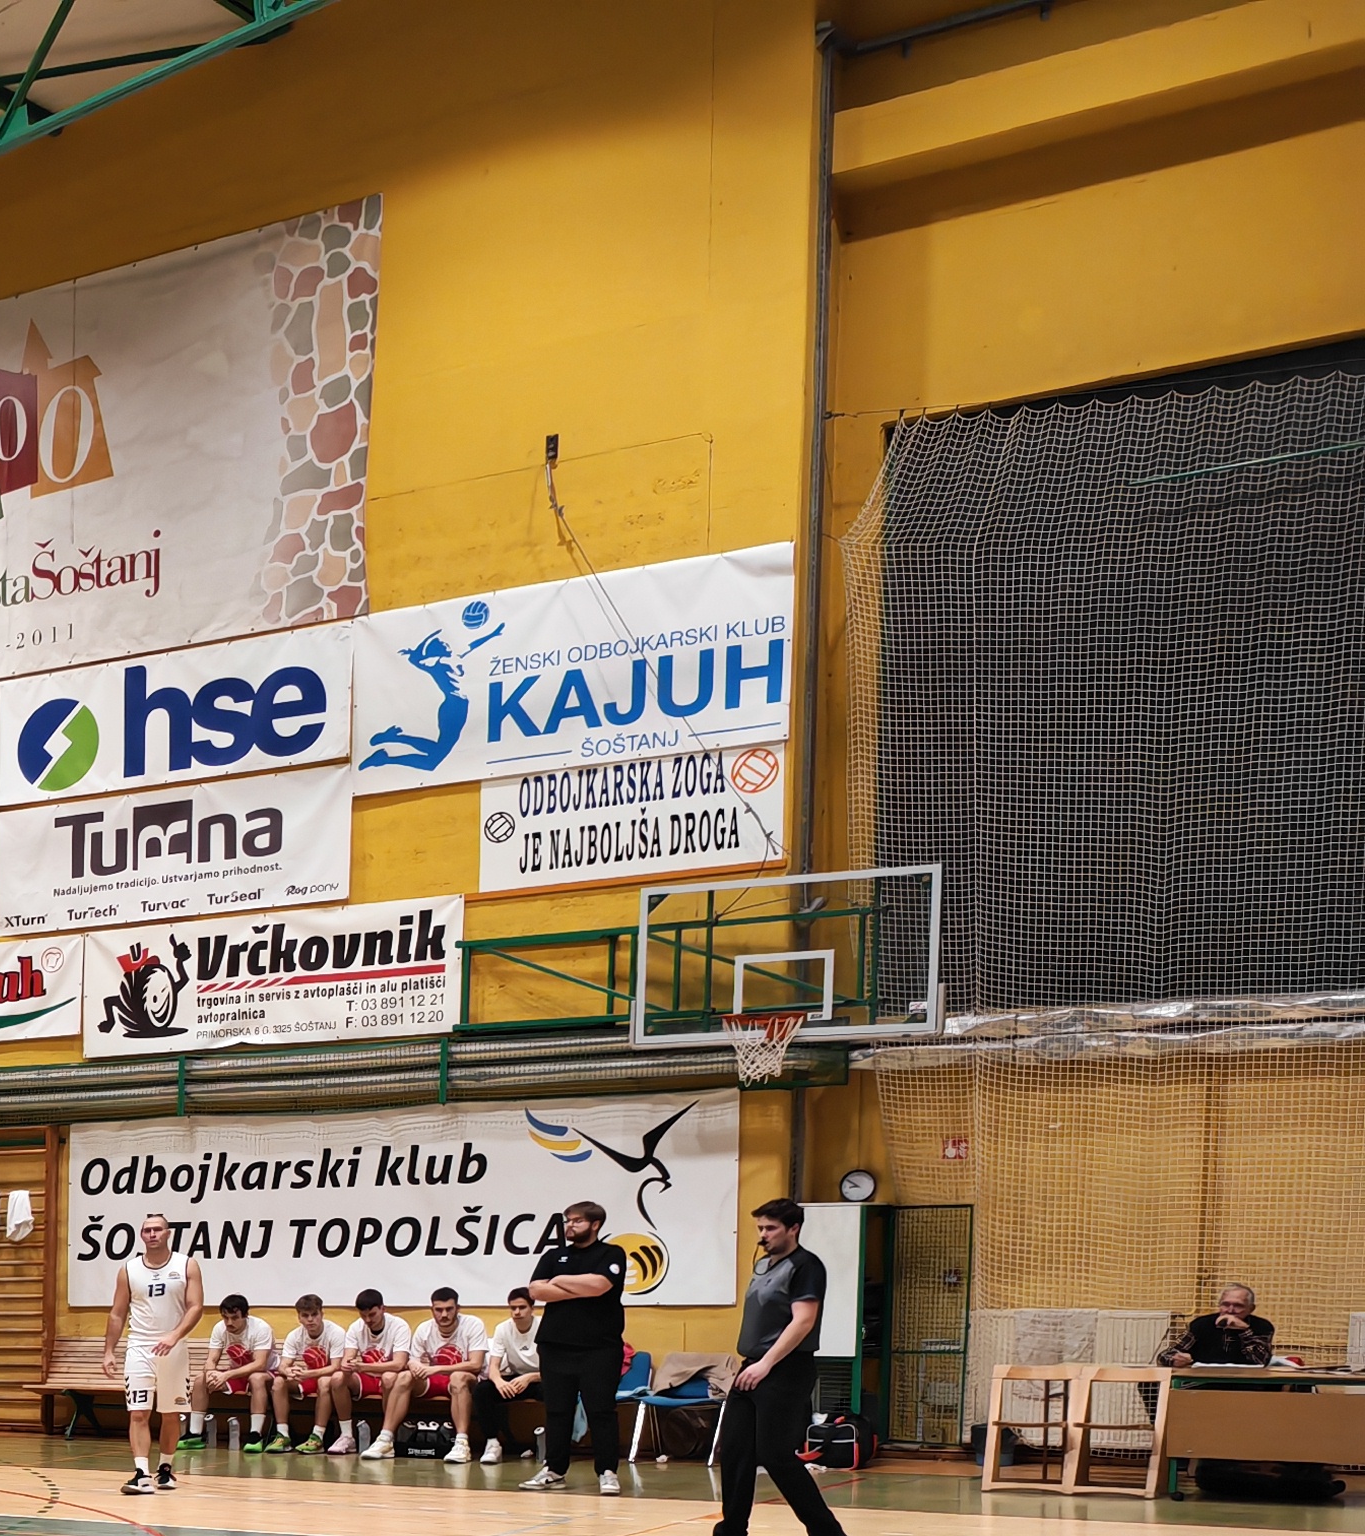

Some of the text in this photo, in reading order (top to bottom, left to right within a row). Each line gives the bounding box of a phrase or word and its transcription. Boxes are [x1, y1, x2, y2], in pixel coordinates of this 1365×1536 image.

[489, 616, 786, 677] ŽENSKI ODBOJKARSKI KLUB
[487, 639, 785, 743] KAJUH
[124, 665, 327, 778] hse
[580, 730, 680, 758] ŠOŠTANJ
[519, 756, 665, 819] ODBOJKARSKA
[519, 807, 740, 874] JE NAJBOLJŠA DROGA
[53, 862, 282, 897] Nadaljujemo tradicijo. Ustvarjamo prihodnost.
[197, 909, 446, 981] Vrčkovnik
[197, 975, 446, 1009] trgovina in servis z avtoplašči in alu platišči
[346, 993, 444, 1012] T: 03 891 12 21
[197, 1008, 266, 1025] avtopralnica
[197, 1027, 251, 1039] PRIMORSKA
[294, 1020, 337, 1032] ŠOŠTANJ
[345, 1017, 357, 1029] F:
[361, 1015, 378, 1027] 03
[381, 1013, 404, 1026] 891
[81, 1142, 488, 1204] Odbojkarski klub
[77, 1205, 567, 1261] ŠOTANJ TOPOLŠICA
[148, 1283, 166, 1297] 13
[132, 1390, 148, 1403] 13
